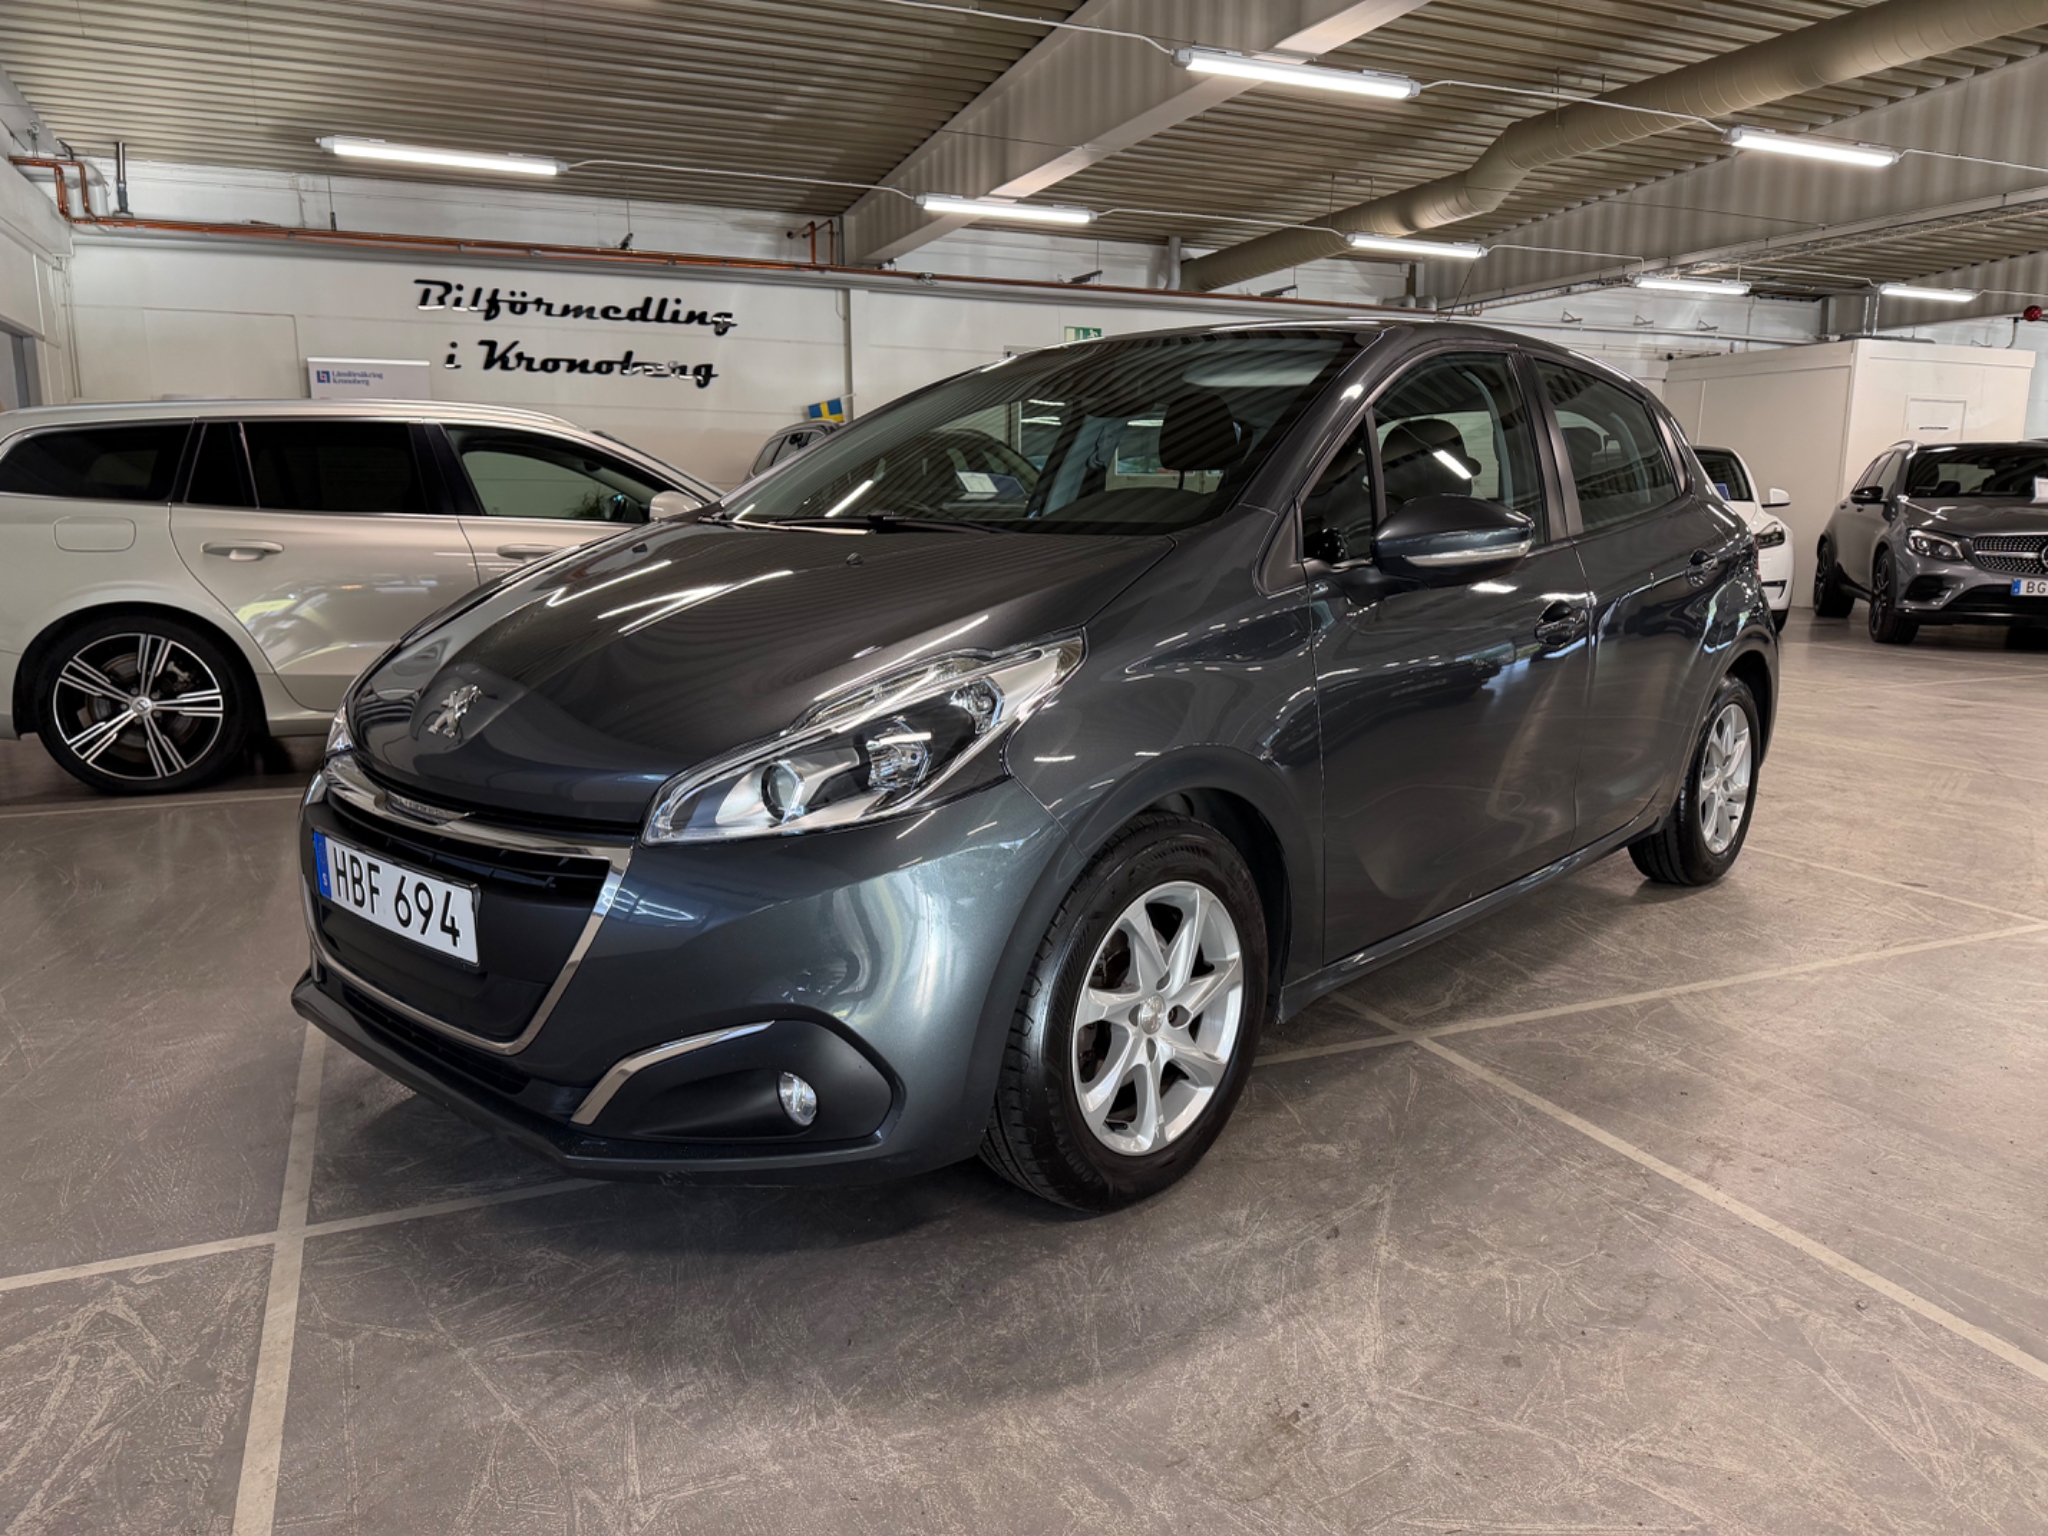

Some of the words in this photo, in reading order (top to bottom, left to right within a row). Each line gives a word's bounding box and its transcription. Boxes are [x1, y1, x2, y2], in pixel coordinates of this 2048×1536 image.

[414, 279, 738, 336] Bilförmedling
[444, 341, 461, 369] i
[333, 847, 380, 915] HBF
[394, 875, 460, 947] 694
